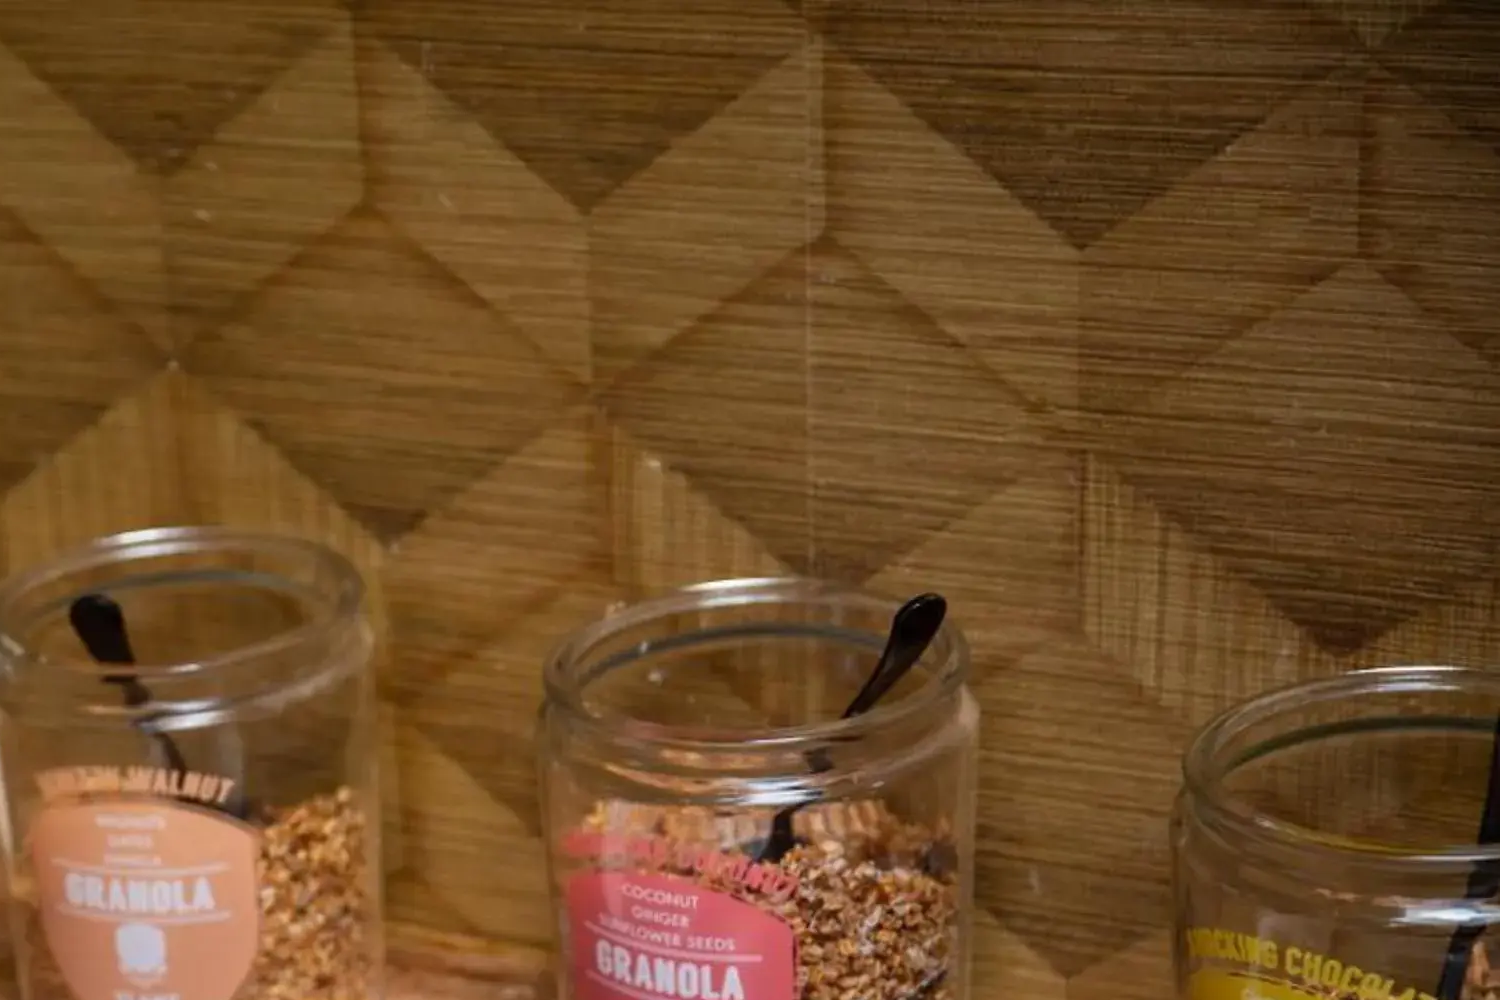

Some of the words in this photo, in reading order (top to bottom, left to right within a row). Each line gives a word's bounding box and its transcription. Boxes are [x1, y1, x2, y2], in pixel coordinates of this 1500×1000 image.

[65, 874, 215, 912] GRANOLA
[621, 882, 699, 909] COCONUT
[599, 911, 681, 948] SUNFLOWER
[686, 935, 736, 952] SEEDS
[630, 904, 690, 928] GINGER
